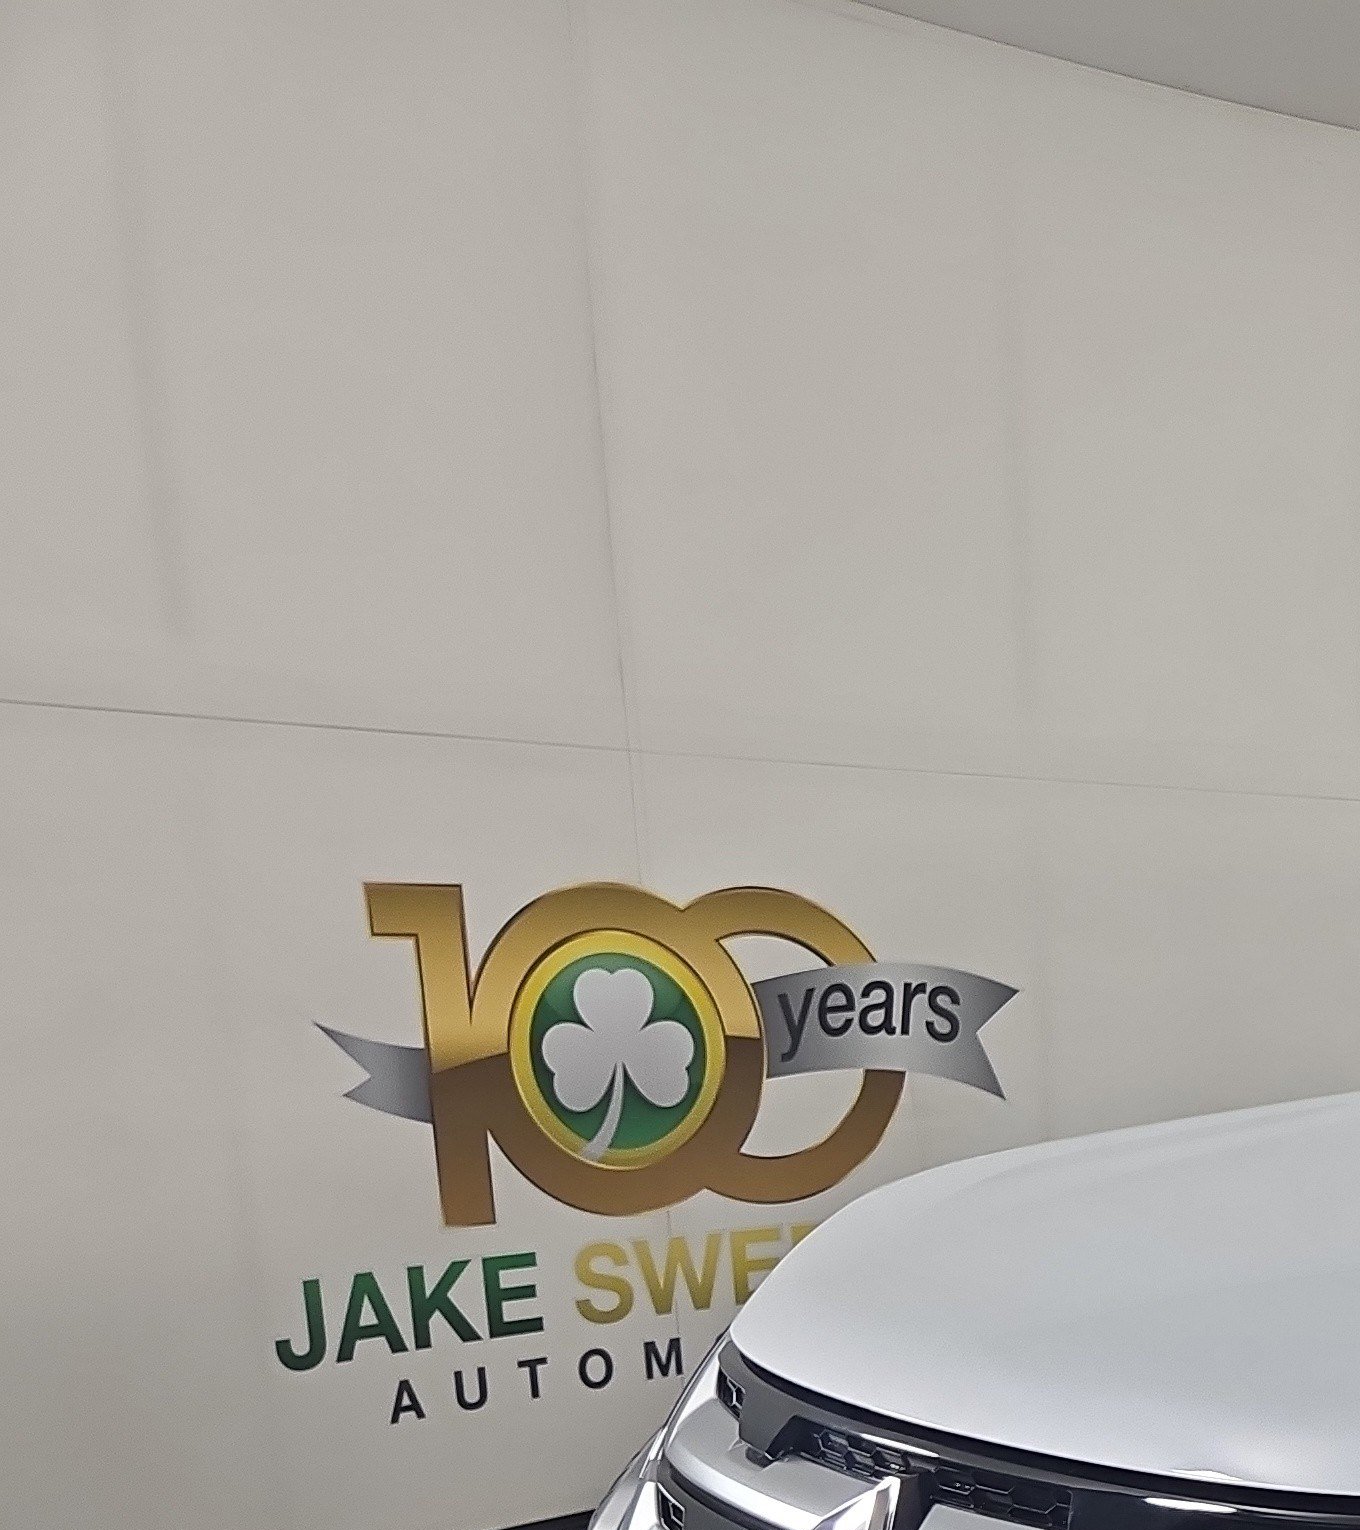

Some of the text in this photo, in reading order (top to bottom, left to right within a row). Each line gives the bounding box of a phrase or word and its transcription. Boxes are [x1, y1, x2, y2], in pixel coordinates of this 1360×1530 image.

[363, 881, 962, 1227] 100 years
[274, 1222, 817, 1373] JAKE SWE
